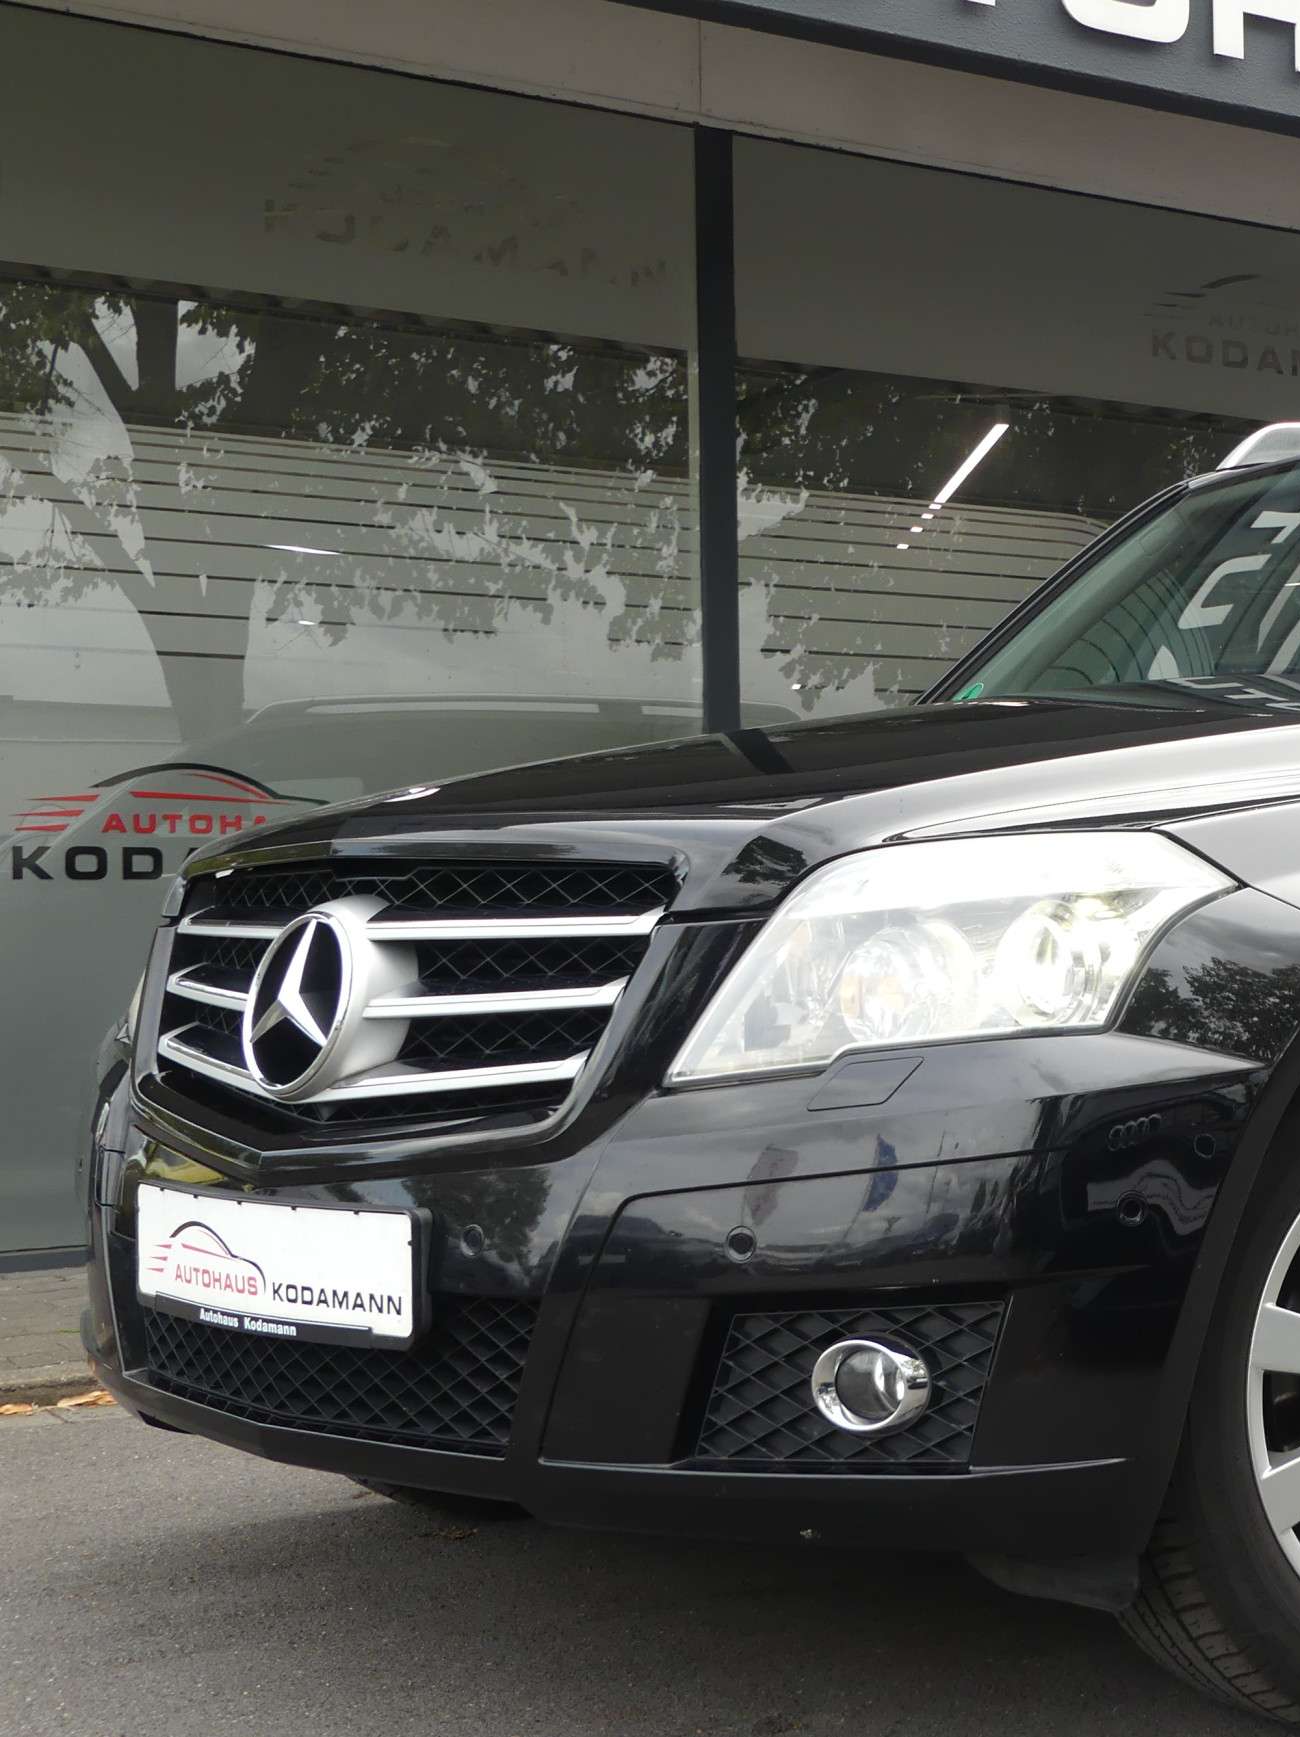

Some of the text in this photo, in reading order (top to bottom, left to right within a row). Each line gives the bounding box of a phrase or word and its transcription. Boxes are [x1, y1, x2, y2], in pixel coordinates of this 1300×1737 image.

[174, 1263, 402, 1316] AUTOHAUS KODAMANN
[200, 1308, 297, 1336] Autohaus Kodamann
